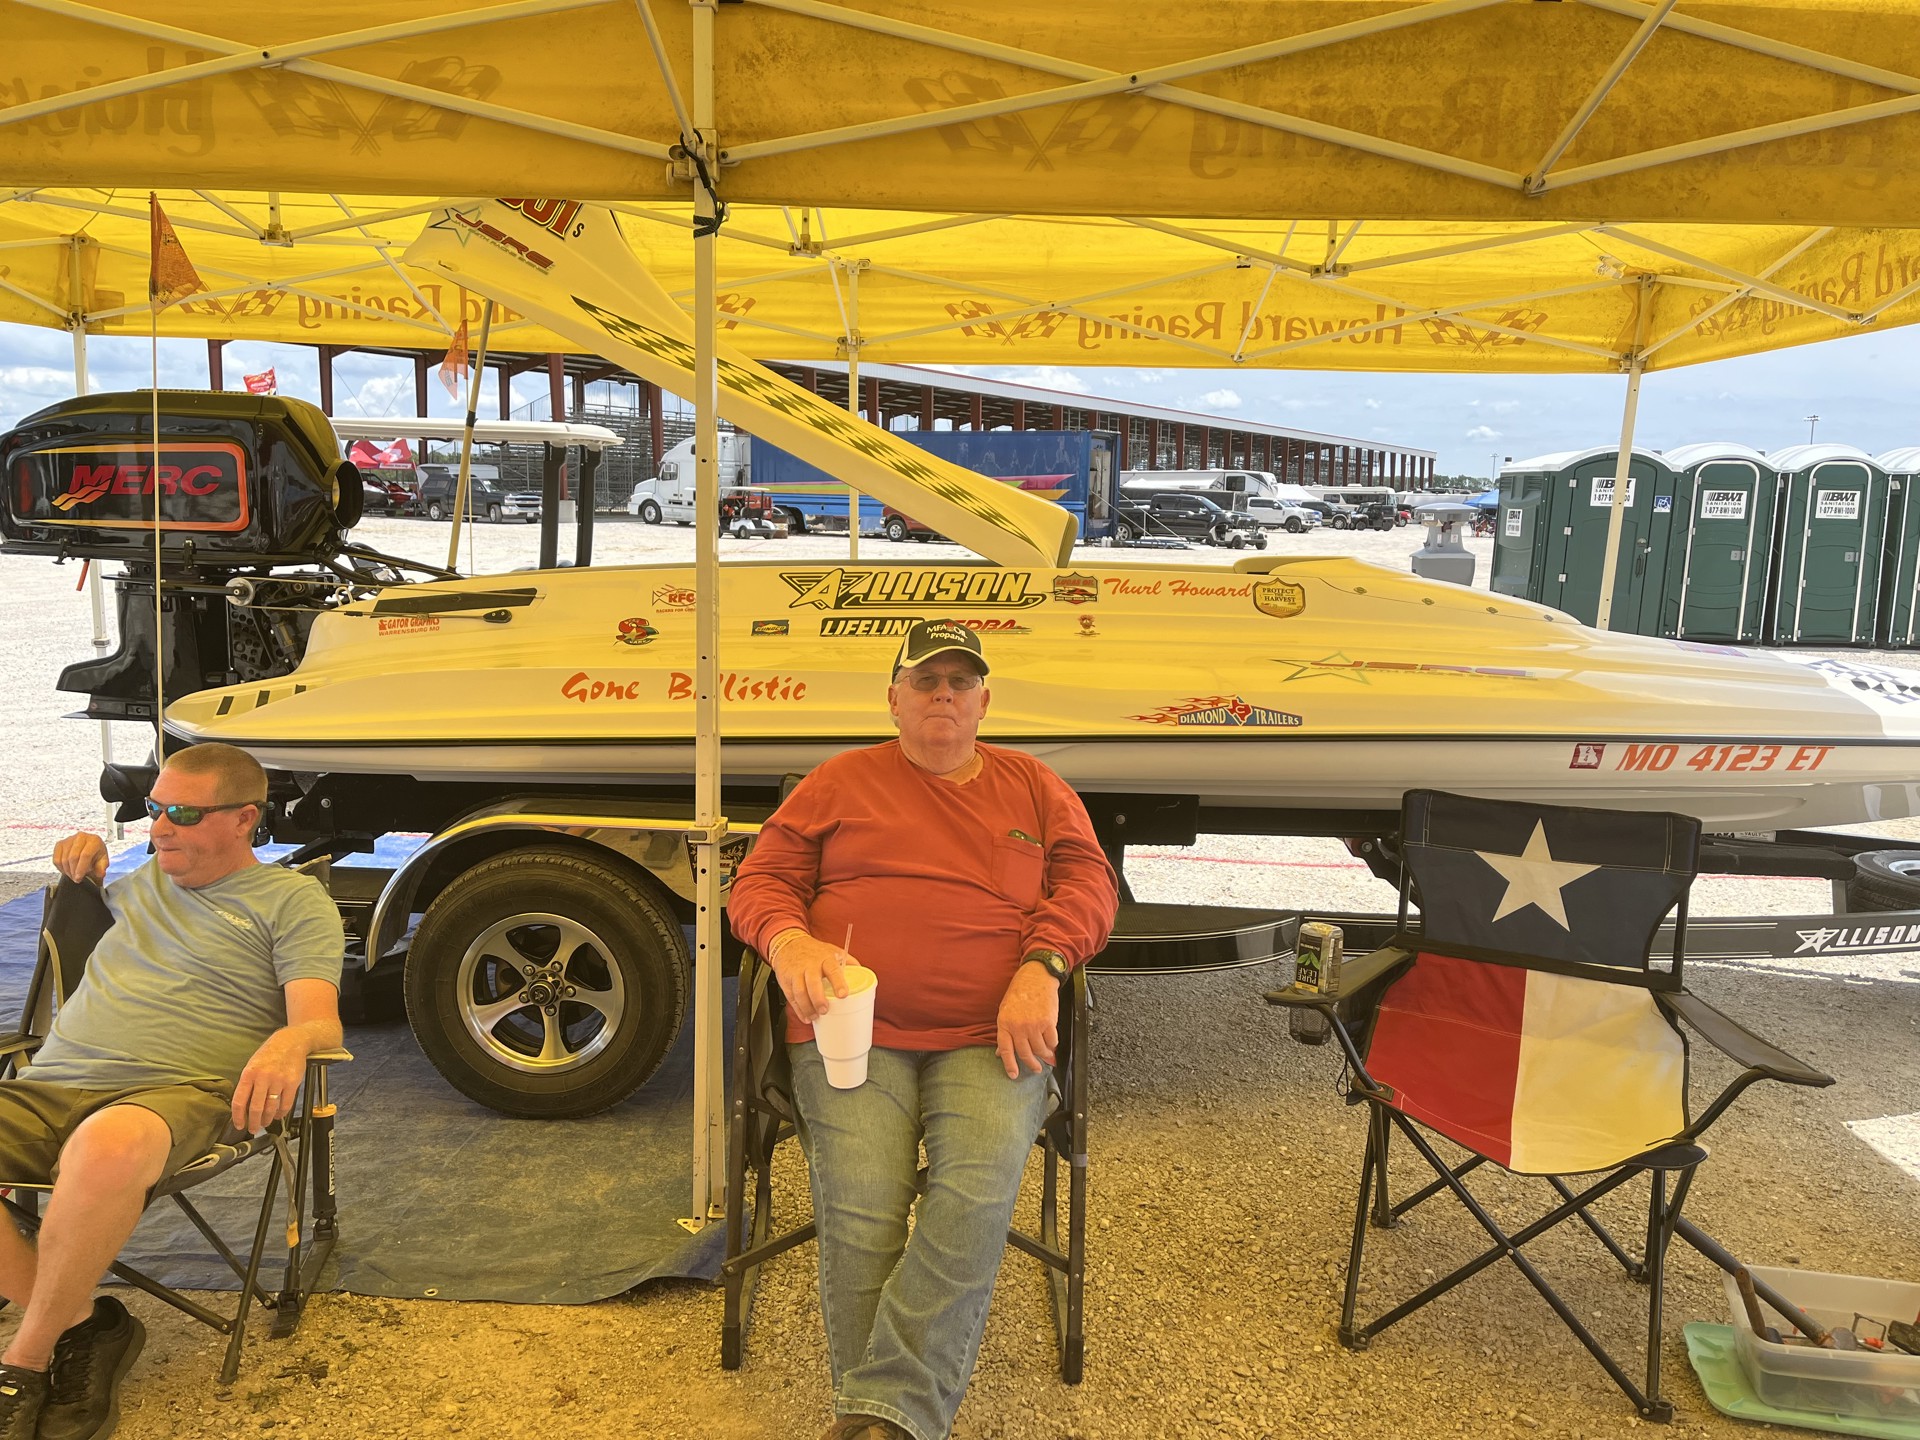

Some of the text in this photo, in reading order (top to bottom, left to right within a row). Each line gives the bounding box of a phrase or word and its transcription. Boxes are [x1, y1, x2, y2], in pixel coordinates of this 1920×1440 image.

[68, 465, 223, 496] MERC
[1714, 492, 1744, 501] BWI
[1828, 492, 1858, 501] BWI
[779, 568, 1046, 610] ALLISON
[1103, 577, 1252, 598] Thurl Howard
[1262, 587, 1295, 595] PROTECT
[1264, 595, 1297, 603] HARVEST
[387, 618, 409, 630] GATOR
[926, 623, 947, 634] MFA
[930, 631, 966, 644] Propane
[561, 671, 640, 703] Gone
[1180, 707, 1300, 726] DIAMOND TRAILERS
[1615, 744, 1836, 772] MO 4123 ET
[1794, 925, 1920, 953] ALLISON
[1299, 967, 1318, 978] LEAF
[1297, 974, 1317, 985] PURE
